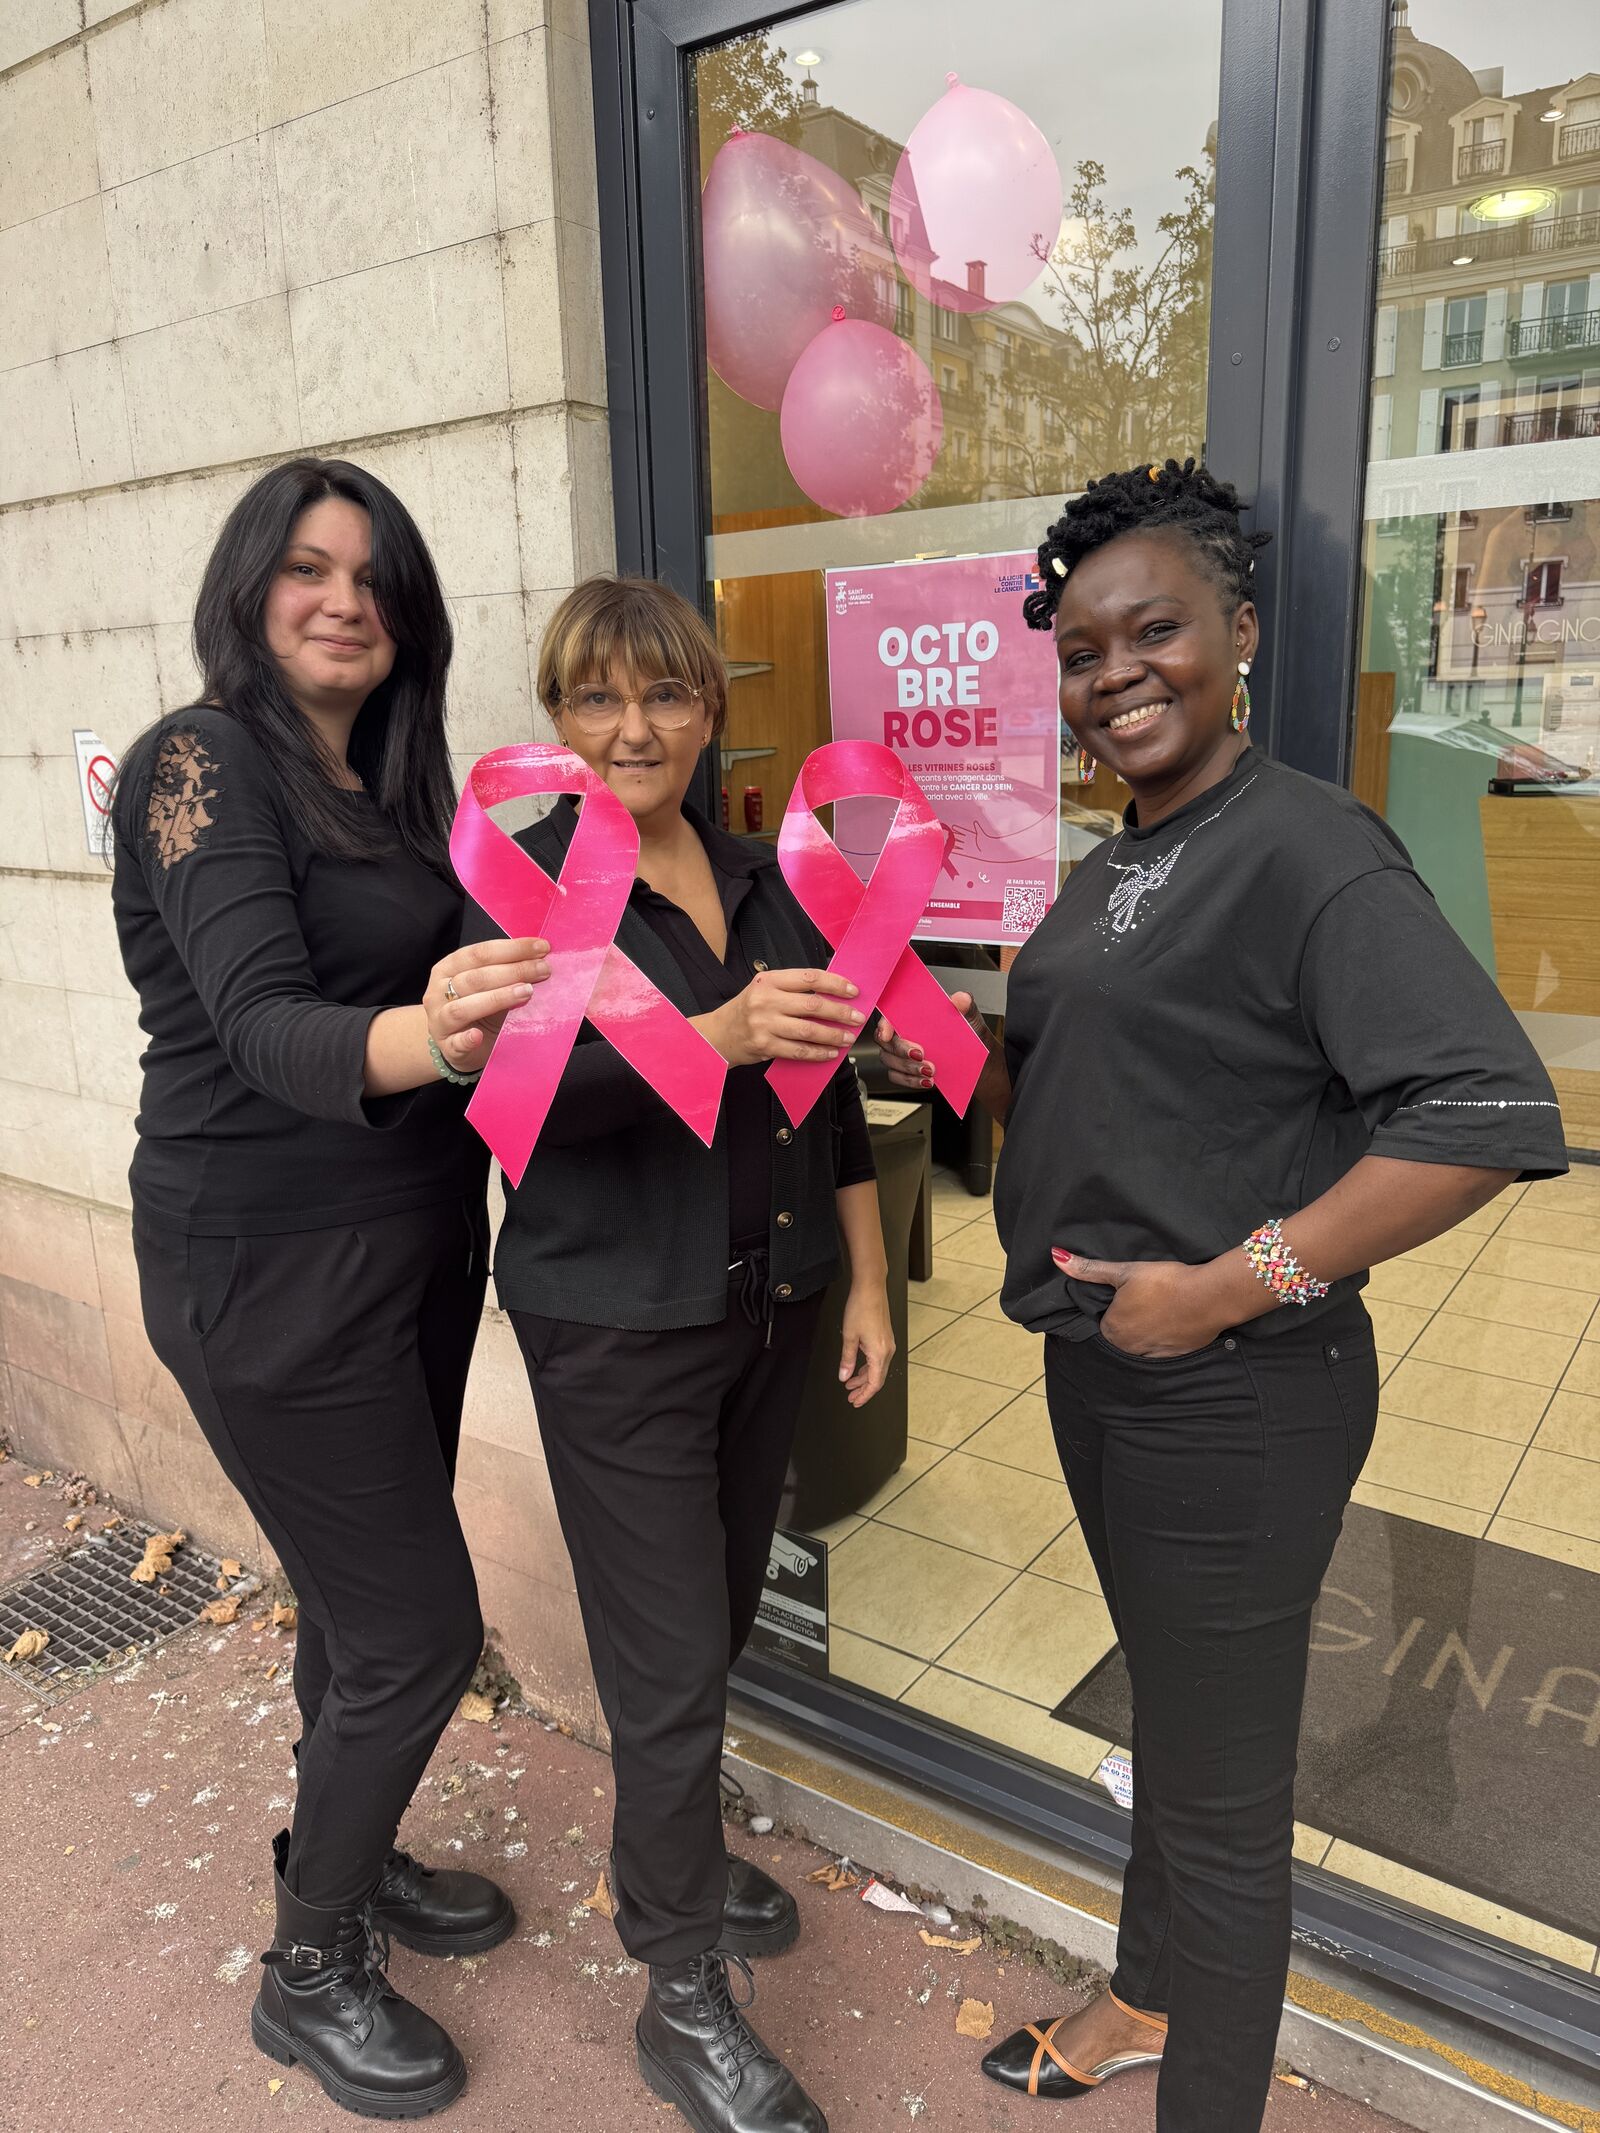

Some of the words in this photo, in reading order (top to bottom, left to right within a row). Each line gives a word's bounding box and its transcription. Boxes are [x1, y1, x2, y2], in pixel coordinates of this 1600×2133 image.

[1471, 620, 1527, 648] GINA
[1537, 616, 1600, 645] GINO
[878, 620, 999, 667] OCTO
[897, 665, 980, 707] BRE
[883, 708, 998, 748] ROSE
[908, 764, 923, 772] LES
[924, 763, 965, 772] VITRINES
[966, 762, 996, 771] ROSES
[941, 783, 949, 791] le
[949, 783, 978, 791] CANCER
[982, 783, 993, 791] DU
[994, 783, 1014, 792] SEIN,
[926, 793, 944, 801] ariat
[964, 793, 972, 801] la
[930, 901, 961, 909] ENSEMBLE
[794, 1616, 813, 1628] SOUS
[1309, 1585, 1600, 1747] GINA
[1106, 1759, 1132, 1774] VITRI
